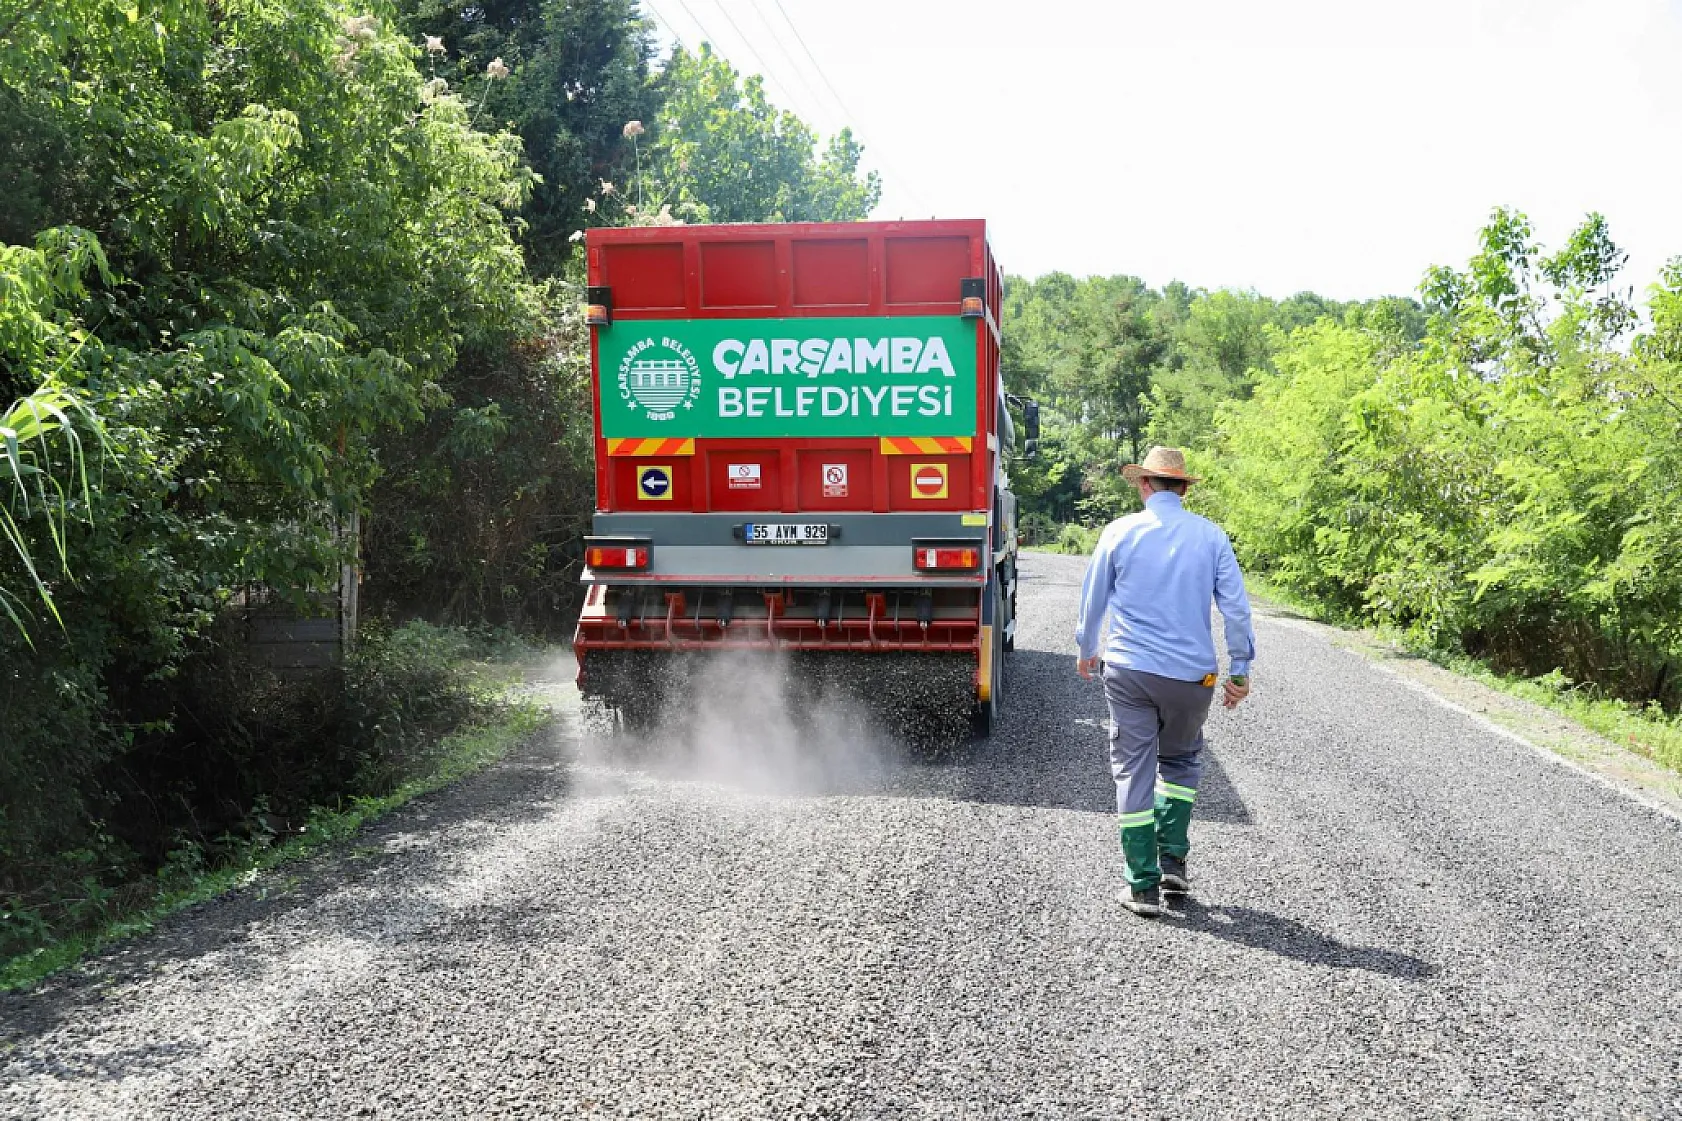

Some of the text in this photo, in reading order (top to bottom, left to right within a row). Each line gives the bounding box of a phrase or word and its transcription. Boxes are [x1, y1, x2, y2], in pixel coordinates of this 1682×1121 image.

[712, 336, 957, 380] ÇARŞAMBA
[754, 525, 768, 539] 55
[804, 525, 826, 539] 929
